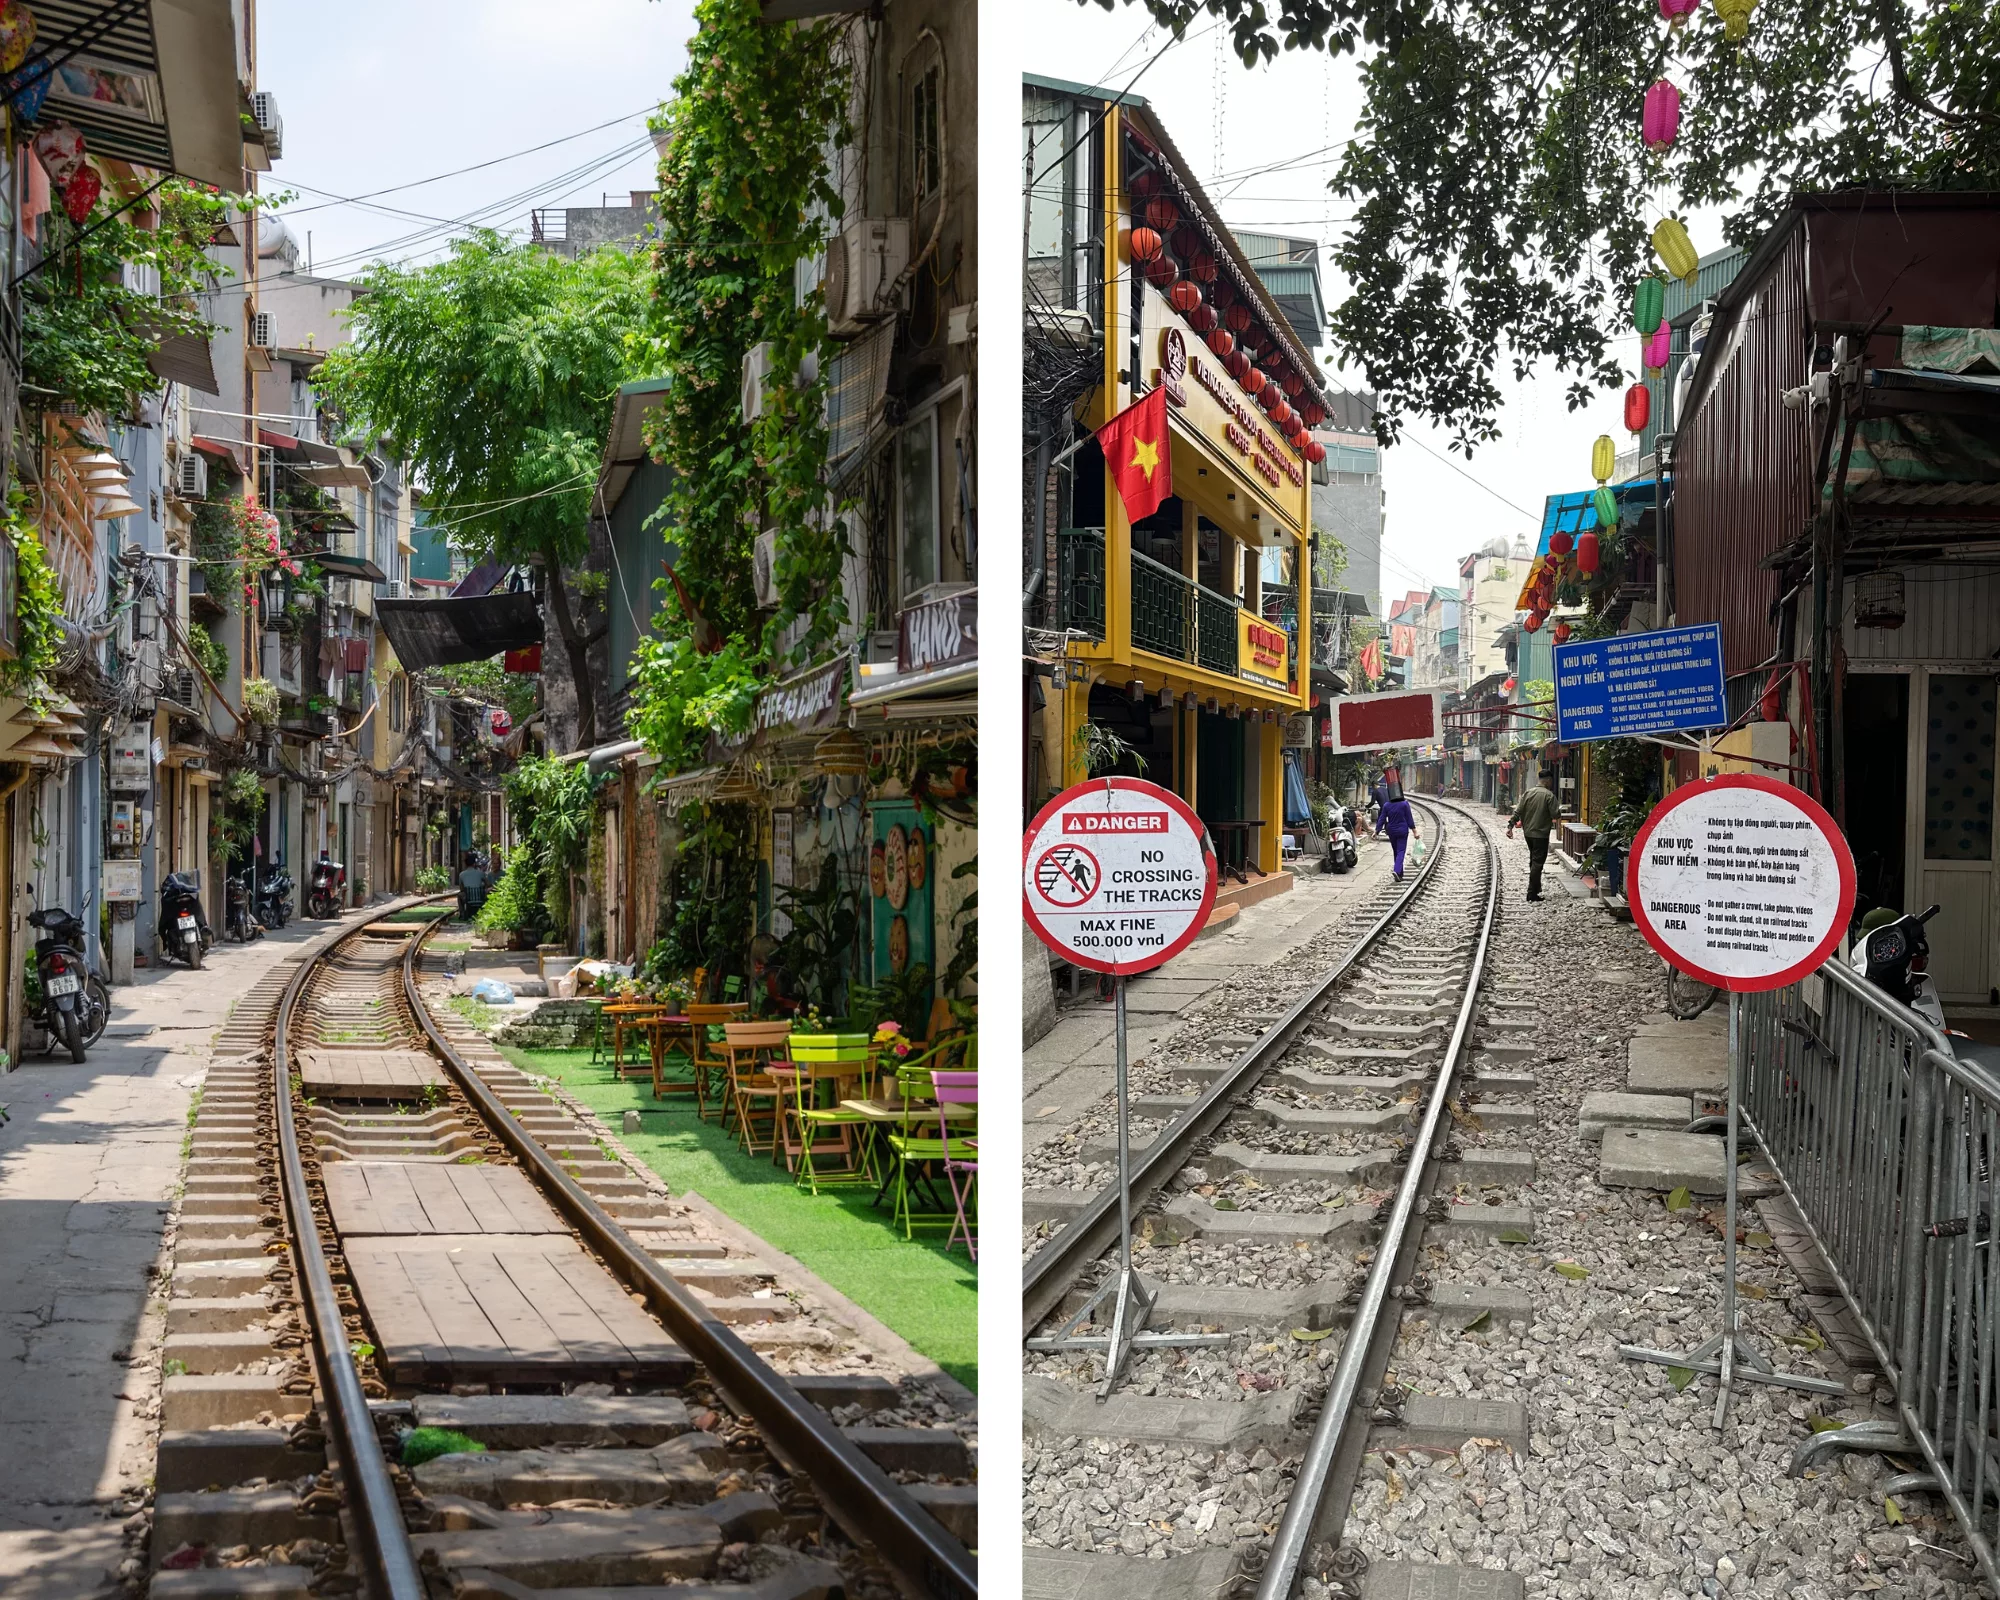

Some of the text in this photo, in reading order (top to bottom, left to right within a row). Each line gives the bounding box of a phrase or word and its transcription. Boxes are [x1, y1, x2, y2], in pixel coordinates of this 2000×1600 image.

[909, 597, 962, 668] HANOI
[1563, 652, 1598, 668] KHU VỰC
[1560, 668, 1604, 688] NGUY HIỂM
[1627, 693, 1644, 701] GATHER
[1648, 690, 1666, 698] CROWD,
[1678, 686, 1698, 694] PHOTOS,
[1698, 684, 1714, 692] VIDEOS
[1643, 702, 1658, 710] STAND,
[1674, 697, 1696, 705] RAILROAD
[1696, 695, 1714, 703] TRACKS
[1562, 705, 1604, 718] DANGEROUS
[1648, 710, 1665, 718] CHAIRS,
[1666, 709, 1682, 717] TABLES
[1692, 706, 1710, 714] PEDDLE
[1574, 720, 1592, 730] AREA
[1636, 722, 1656, 730] RAILROAD
[1086, 816, 1162, 830] DANGER
[1658, 838, 1694, 851] KHU VỰC
[1141, 850, 1164, 862] NO
[1652, 852, 1698, 866] NGUY HIỂM
[1112, 870, 1192, 883] CROSSING
[1104, 888, 1202, 902] THE TRACKS
[1650, 902, 1700, 914] DANGEROUS
[1708, 900, 1714, 908] Do
[1724, 901, 1740, 910] gather
[1746, 902, 1763, 911] crowd,
[1764, 904, 1776, 912] take
[1776, 904, 1795, 914] photos,
[1796, 906, 1813, 915] videos
[1080, 919, 1156, 932] MAX FINE
[1664, 919, 1686, 930] AREA
[1708, 912, 1714, 921] Do
[1724, 914, 1738, 923] walk,
[1739, 916, 1754, 924] stand,
[1770, 918, 1790, 926] railroad
[1792, 920, 1808, 928] tracks
[1073, 934, 1164, 947] 500.000 vnd
[1708, 926, 1714, 934] Do
[1715, 927, 1723, 935] not
[1724, 928, 1742, 937] display
[1743, 930, 1760, 938] chairs,
[1761, 930, 1777, 939] Tables
[1778, 932, 1788, 940] and
[1788, 933, 1806, 942] peddle
[1717, 940, 1731, 950] along
[1732, 942, 1752, 950] railroad
[1752, 944, 1768, 952] tracks
